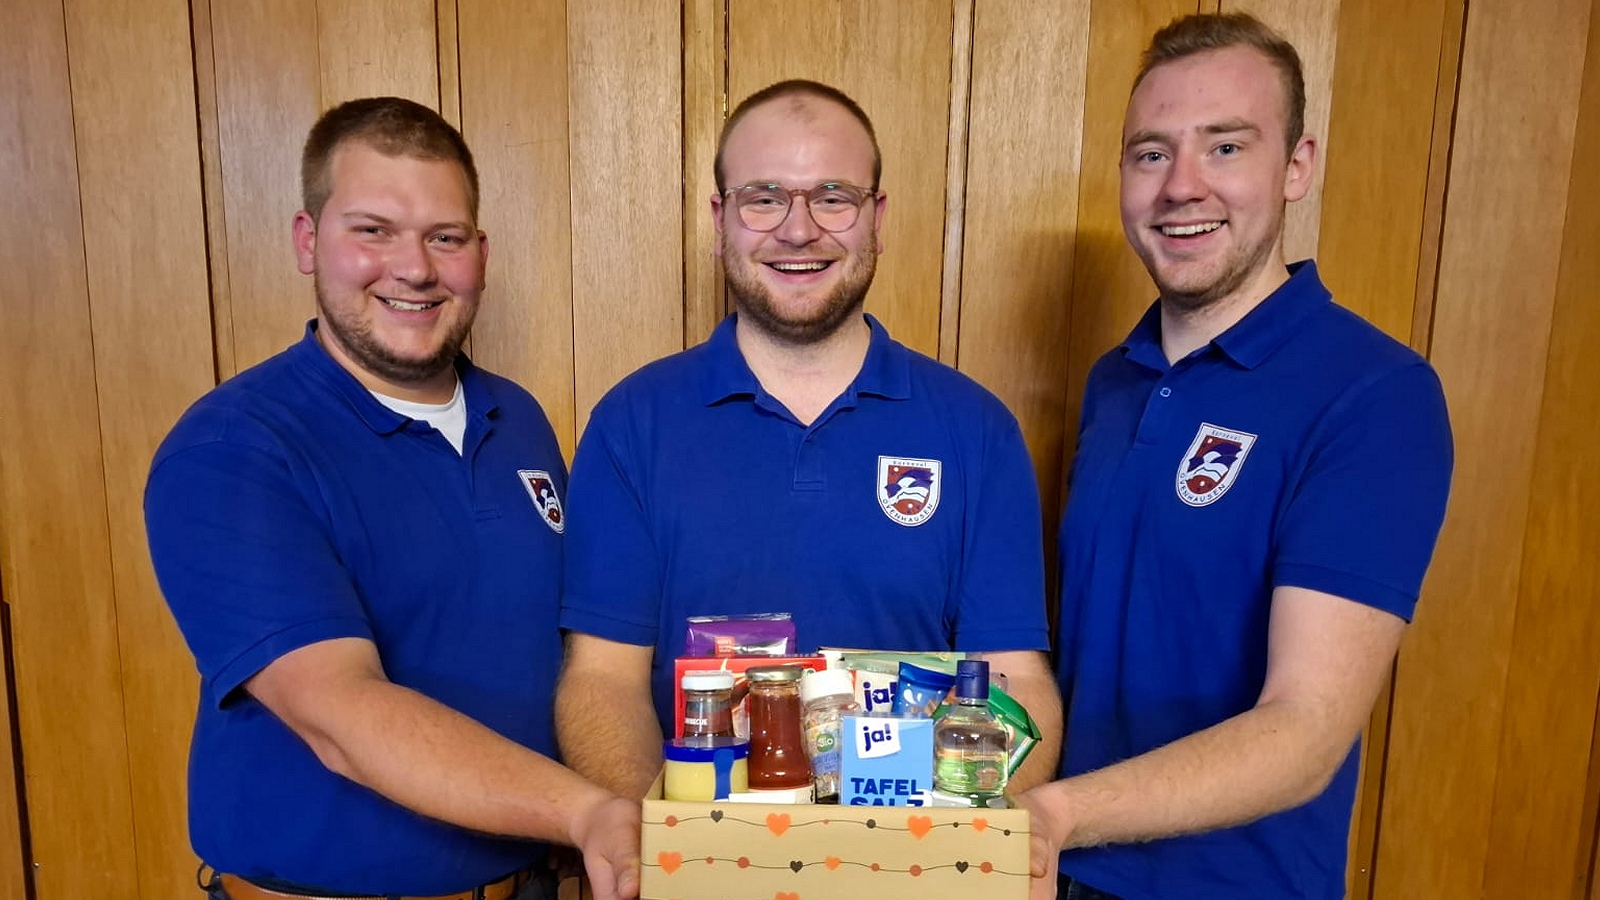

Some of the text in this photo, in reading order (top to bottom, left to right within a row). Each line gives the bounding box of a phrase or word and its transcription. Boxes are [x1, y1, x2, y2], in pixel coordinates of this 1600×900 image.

[1179, 472, 1226, 502] OVENHAUSEN
[882, 498, 933, 523] OVENHAUSEN
[862, 681, 897, 712] ja!
[862, 723, 892, 752] ja!
[850, 777, 924, 796] TAFEL
